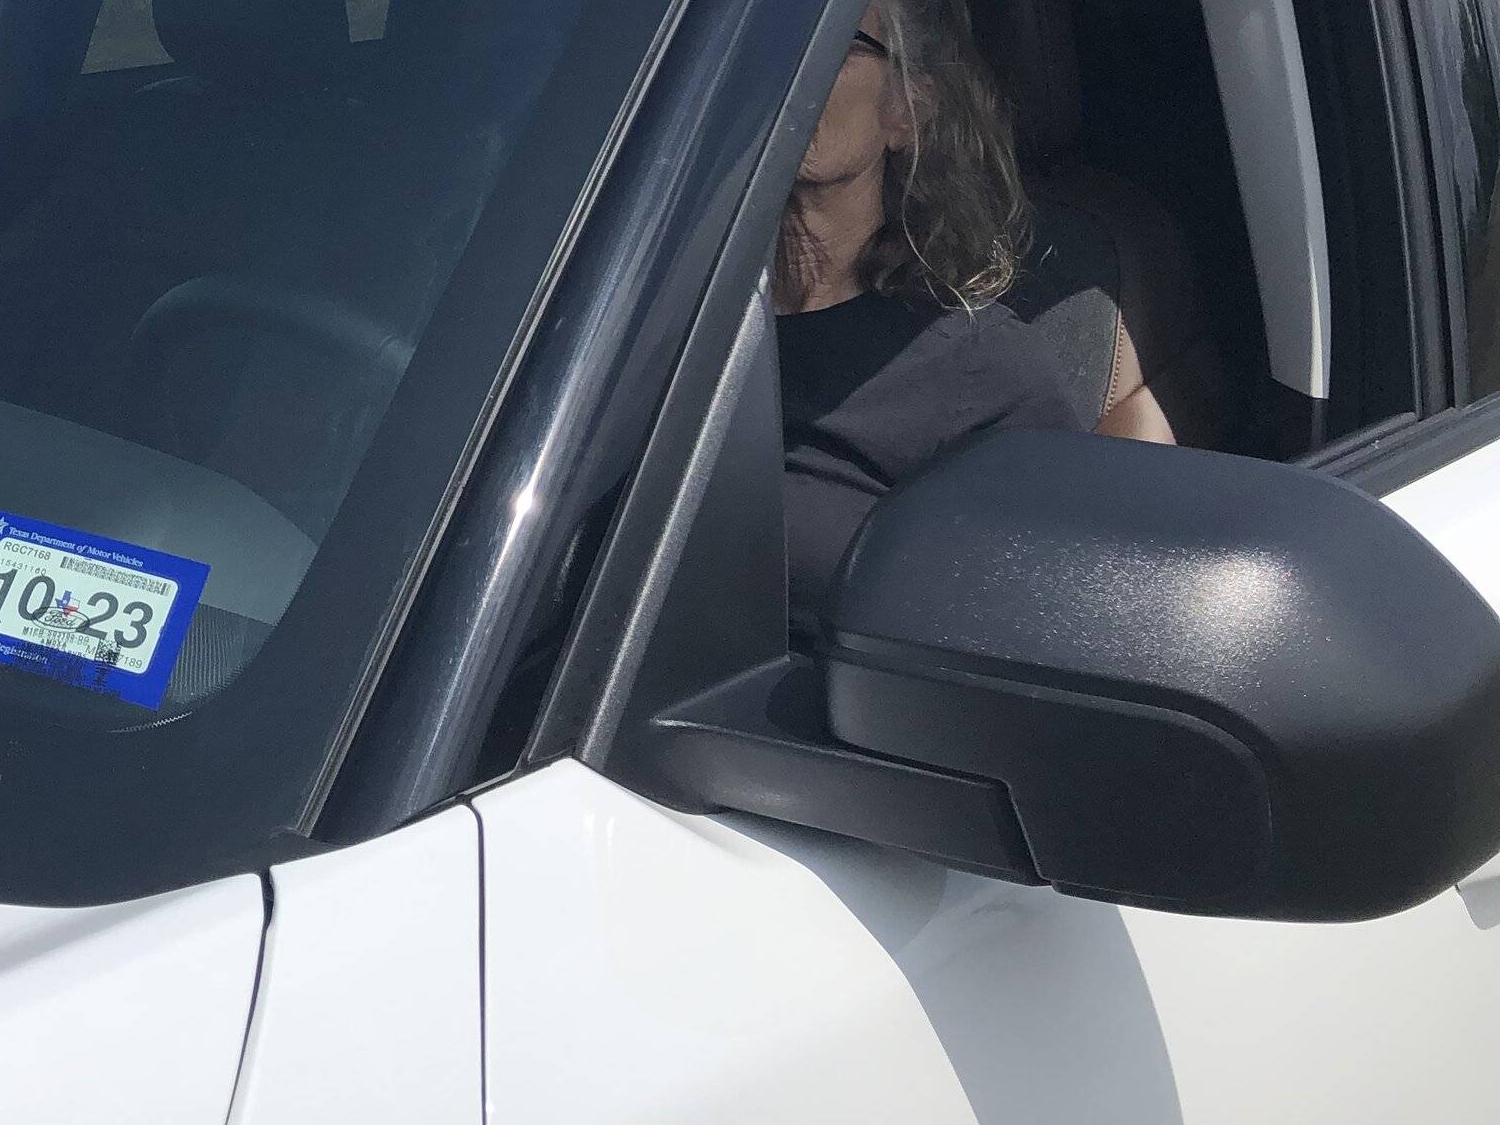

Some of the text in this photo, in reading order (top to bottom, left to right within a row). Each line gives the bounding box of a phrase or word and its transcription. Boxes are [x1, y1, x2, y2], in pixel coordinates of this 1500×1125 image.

[3, 541, 51, 561] RGC7168
[9, 526, 144, 568] Texas Department of Motor Vehicles
[77, 591, 155, 649] 23
